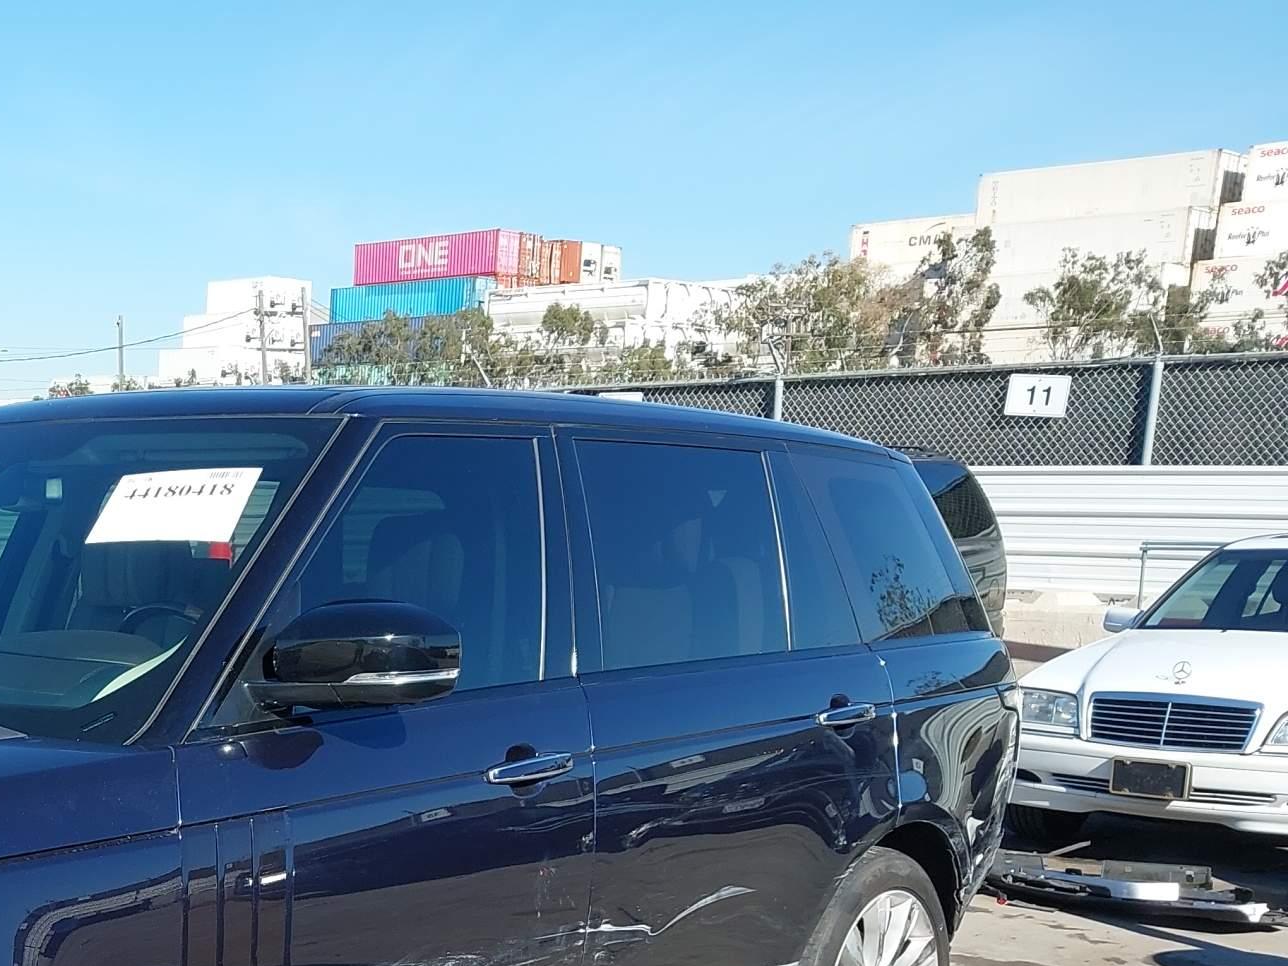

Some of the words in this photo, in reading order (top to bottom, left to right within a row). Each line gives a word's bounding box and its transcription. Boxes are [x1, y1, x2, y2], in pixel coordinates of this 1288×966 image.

[1259, 147, 1288, 158] seac
[1231, 205, 1265, 216] seaco
[398, 239, 448, 268] ONE
[1027, 385, 1052, 406] 11
[125, 483, 234, 499] 44180418
